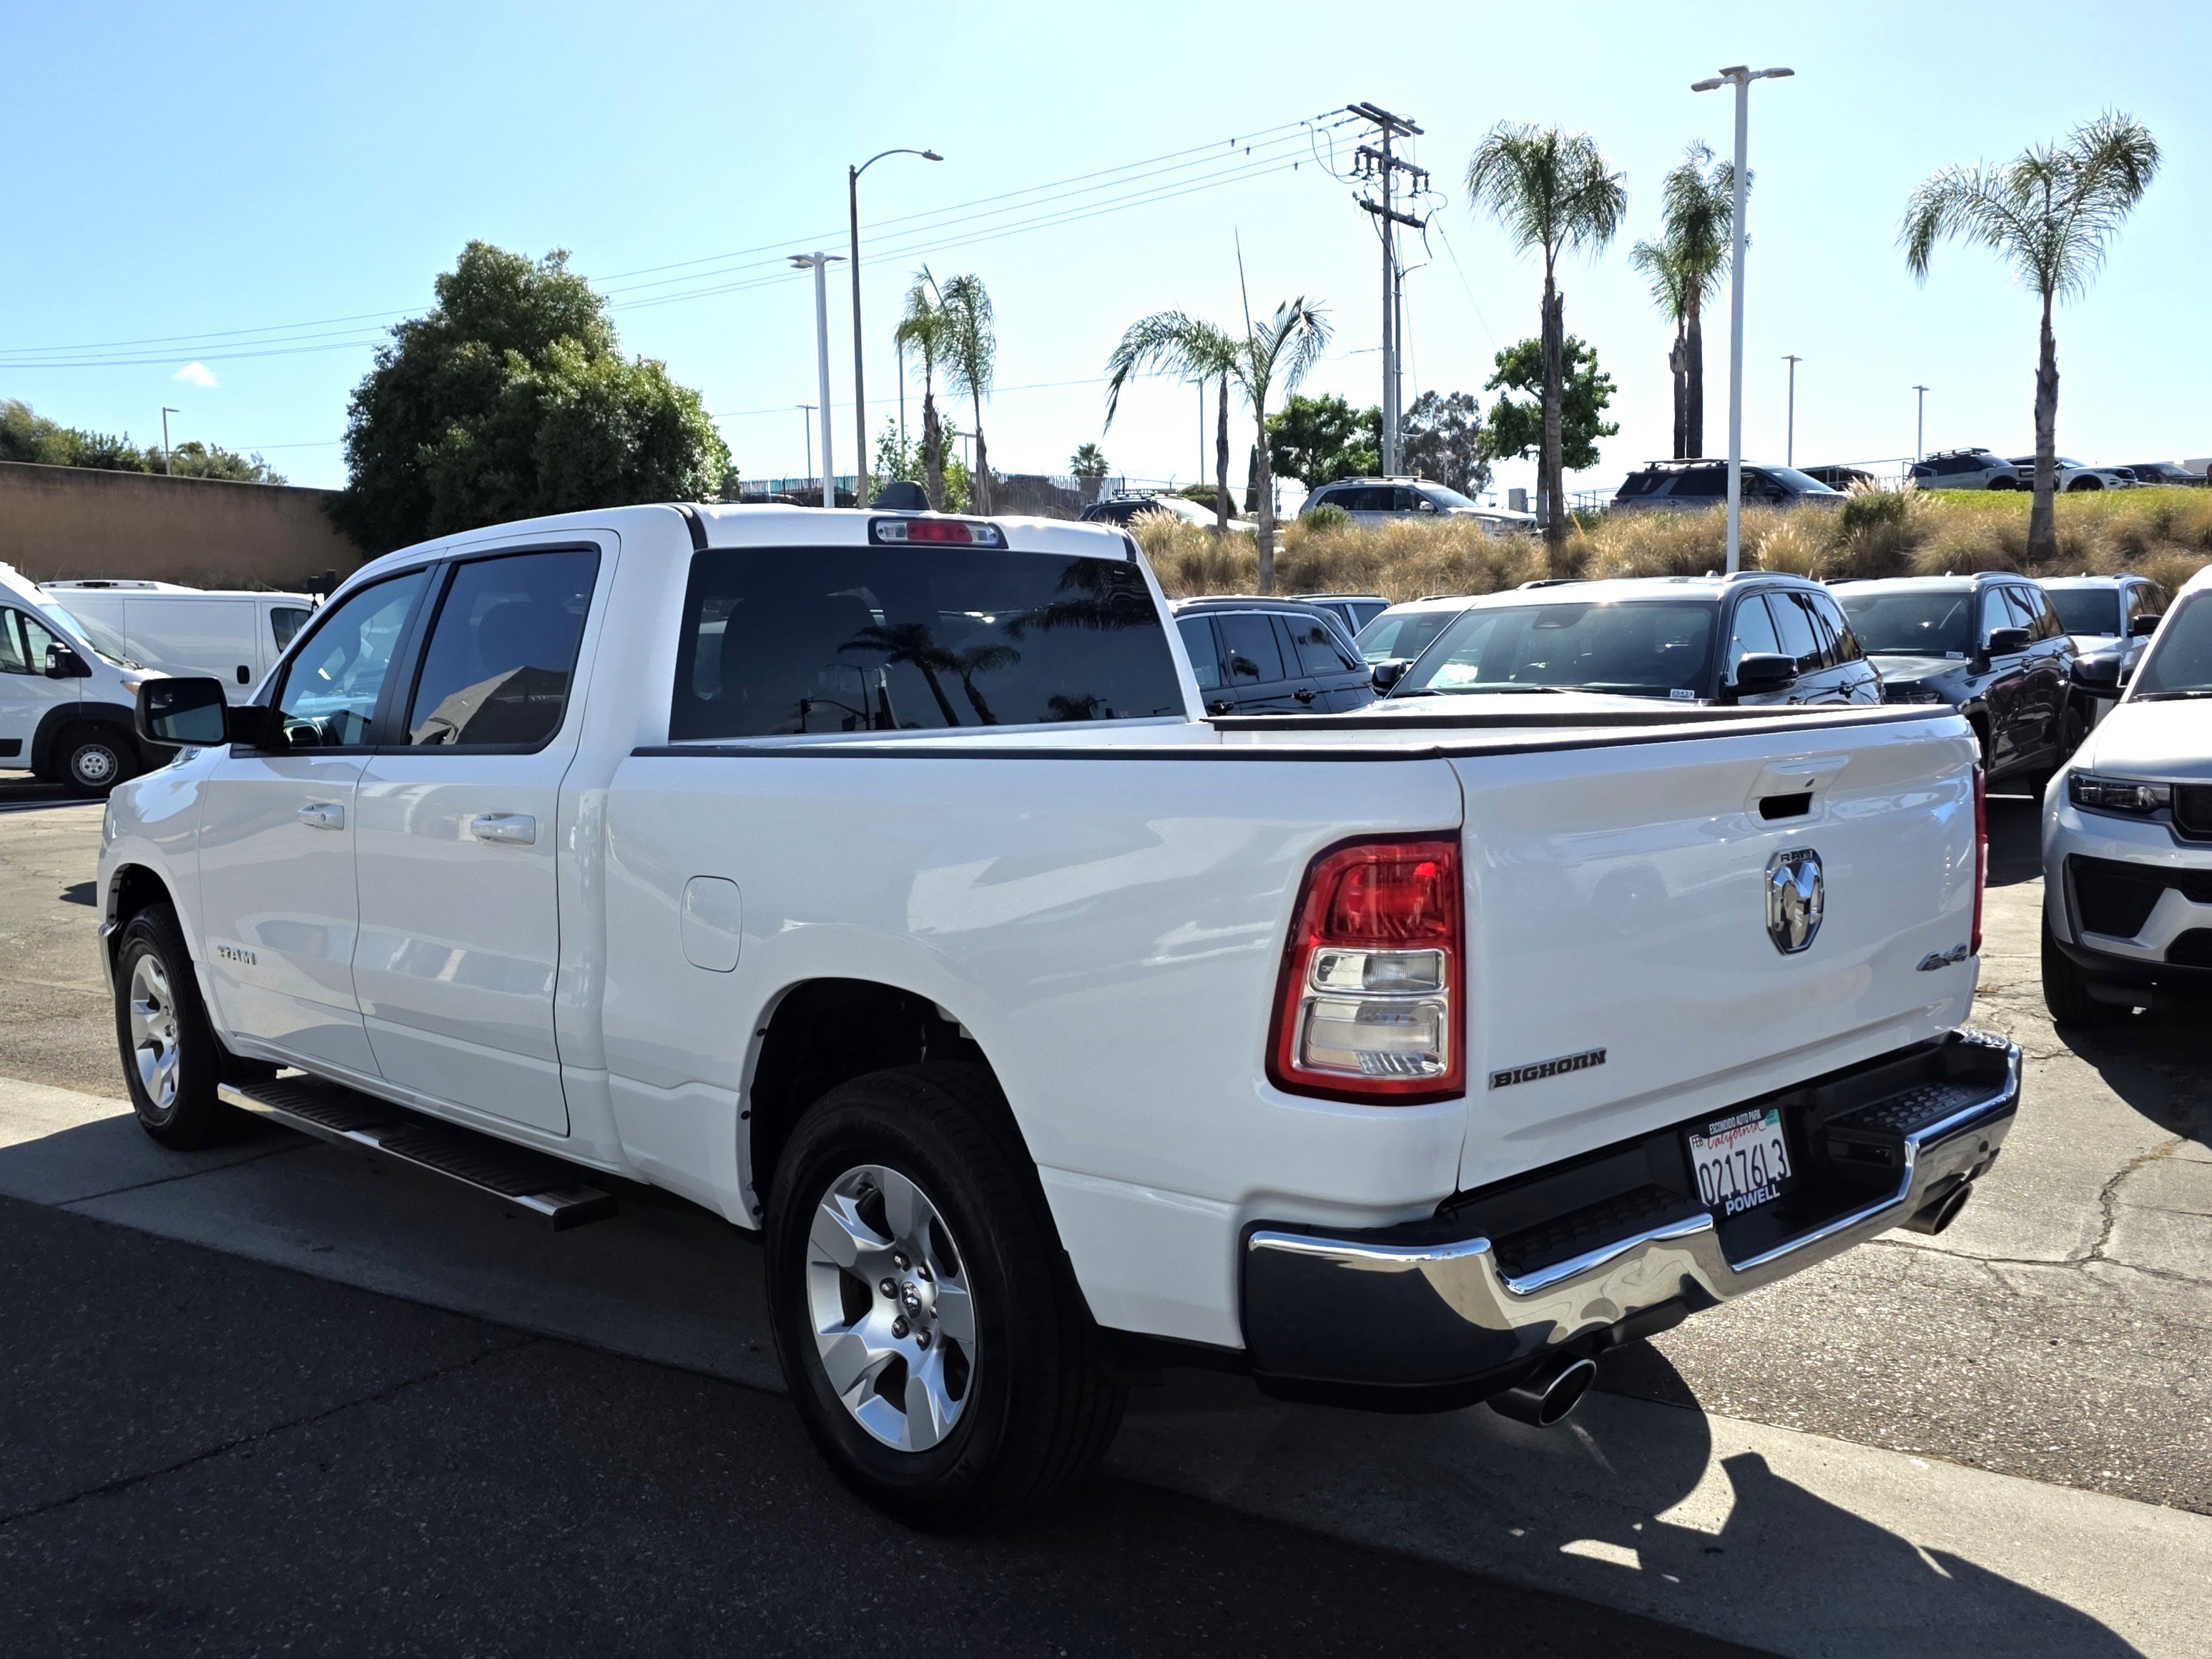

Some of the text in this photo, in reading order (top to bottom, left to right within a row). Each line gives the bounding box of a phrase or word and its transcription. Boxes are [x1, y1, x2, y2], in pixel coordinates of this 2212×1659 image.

[1780, 850, 1813, 862] RAM
[1489, 1047, 1607, 1090] BIGHORN
[1736, 1112, 1749, 1128] AUTO
[1749, 1108, 1762, 1122] PARK
[1707, 1121, 1766, 1150] California
[1699, 1138, 1787, 1206] 02176L3
[1725, 1183, 1781, 1216] POWELL
